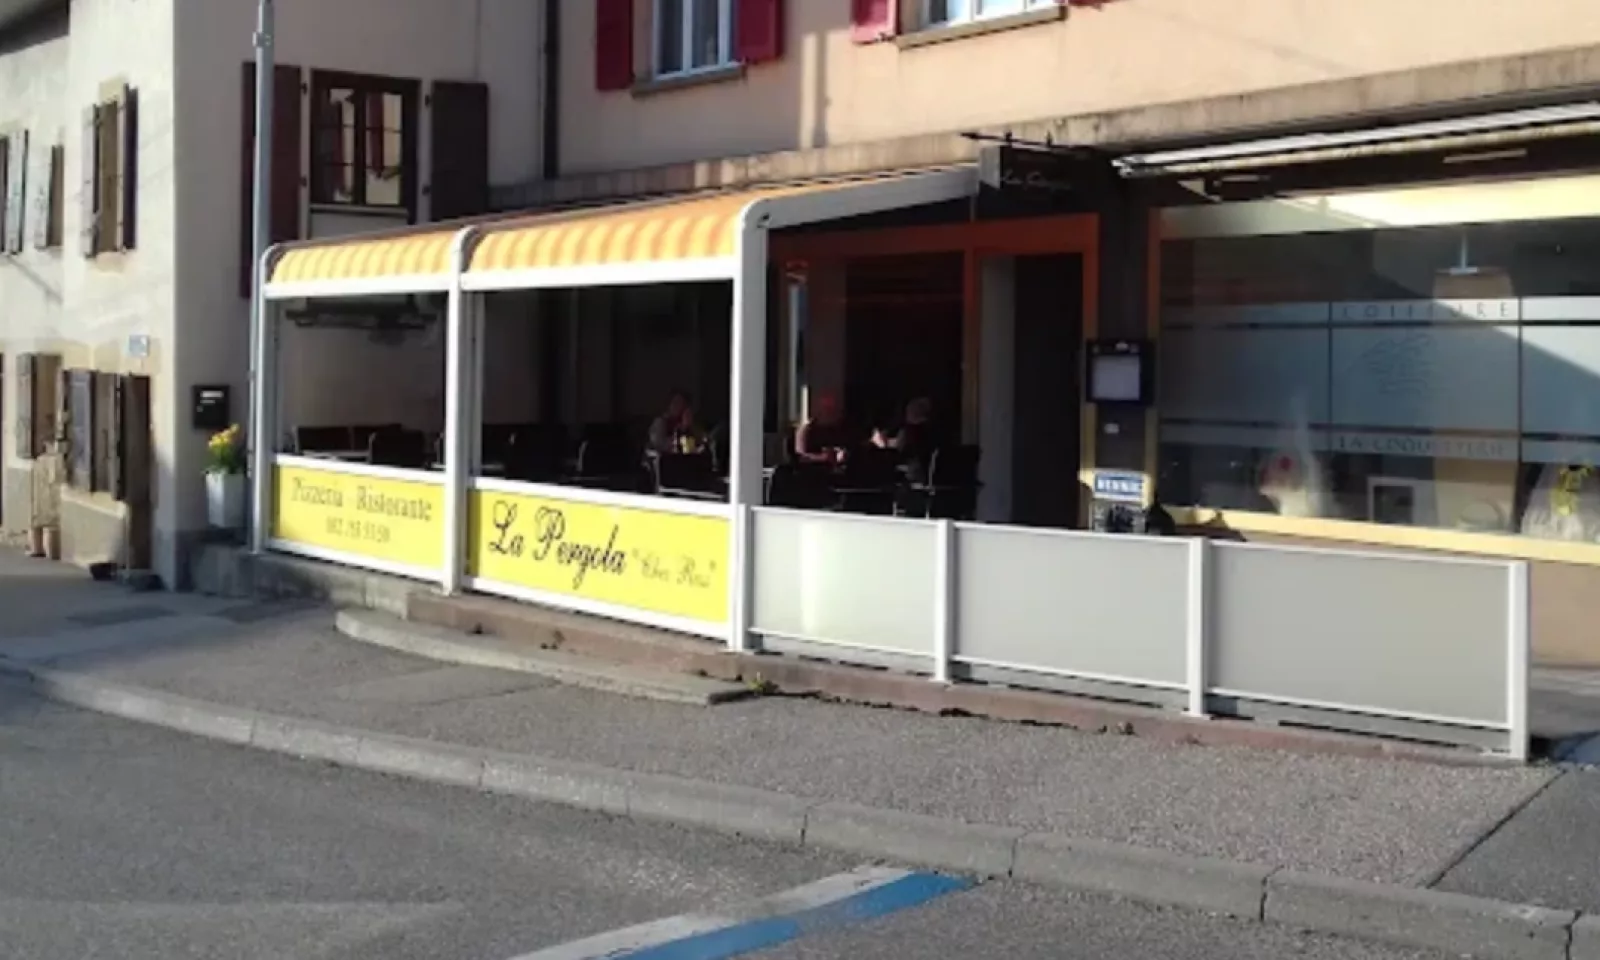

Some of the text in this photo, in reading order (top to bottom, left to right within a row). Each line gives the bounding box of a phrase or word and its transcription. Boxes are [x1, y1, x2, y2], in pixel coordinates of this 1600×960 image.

[356, 483, 432, 522] Ristorante
[487, 500, 524, 557] La
[532, 506, 626, 590] Pergola
